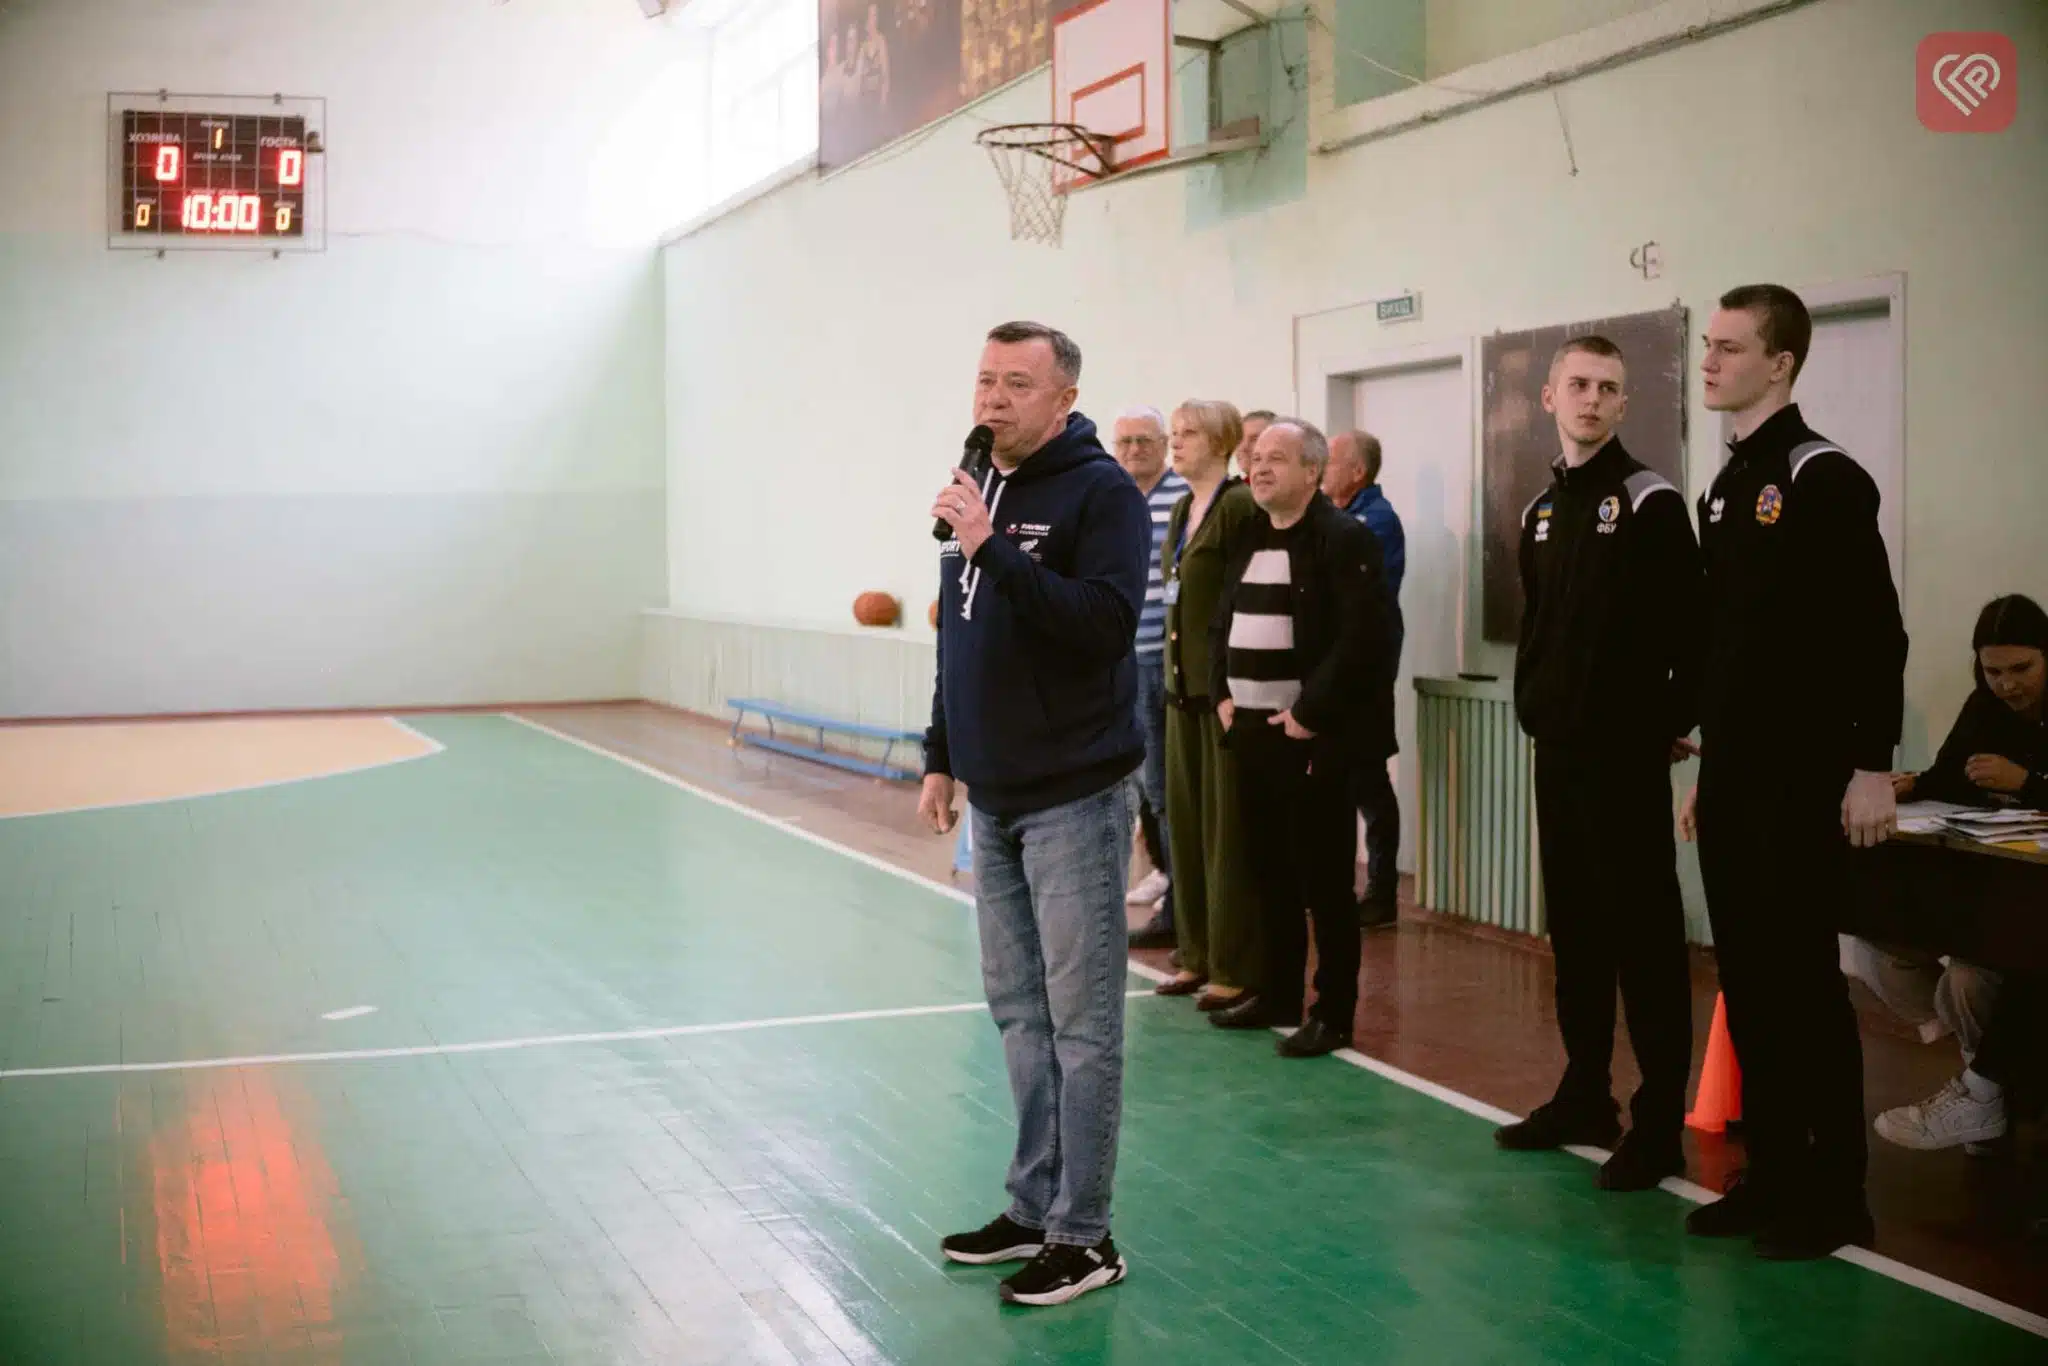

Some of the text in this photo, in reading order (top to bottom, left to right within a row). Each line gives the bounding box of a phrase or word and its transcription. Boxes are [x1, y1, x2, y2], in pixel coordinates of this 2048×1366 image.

[215, 128, 223, 150] 1
[260, 136, 298, 147] ГОСТИ
[156, 145, 180, 181] 0
[278, 150, 301, 184] 0
[135, 203, 150, 227] 0
[182, 194, 261, 230] 10:00
[275, 207, 290, 231] 0
[1596, 522, 1617, 534] ФБУ
